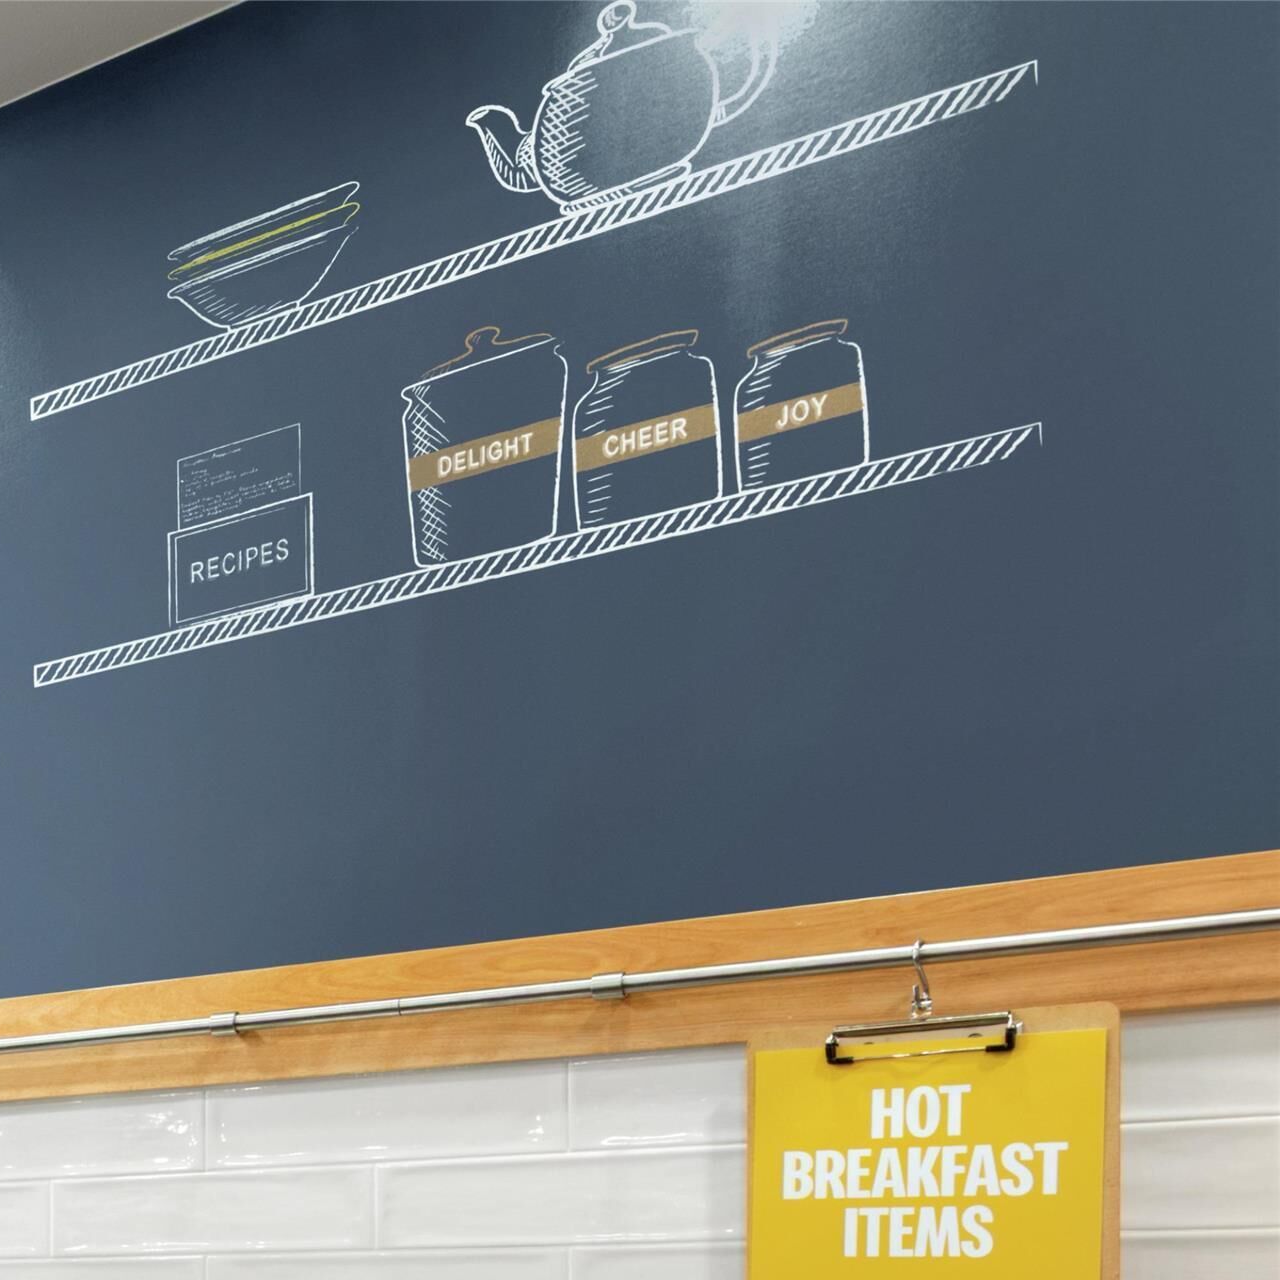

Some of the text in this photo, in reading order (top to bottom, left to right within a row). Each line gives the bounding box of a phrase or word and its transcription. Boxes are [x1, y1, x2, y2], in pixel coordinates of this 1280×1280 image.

[775, 394, 829, 431] JOY
[437, 432, 533, 478] DELIGHT
[602, 417, 688, 458] CHEER
[191, 538, 289, 585] RECIPES
[871, 1084, 971, 1139] HOT
[783, 1142, 1068, 1199] BREAKFAST
[844, 1205, 994, 1258] ITEMS
